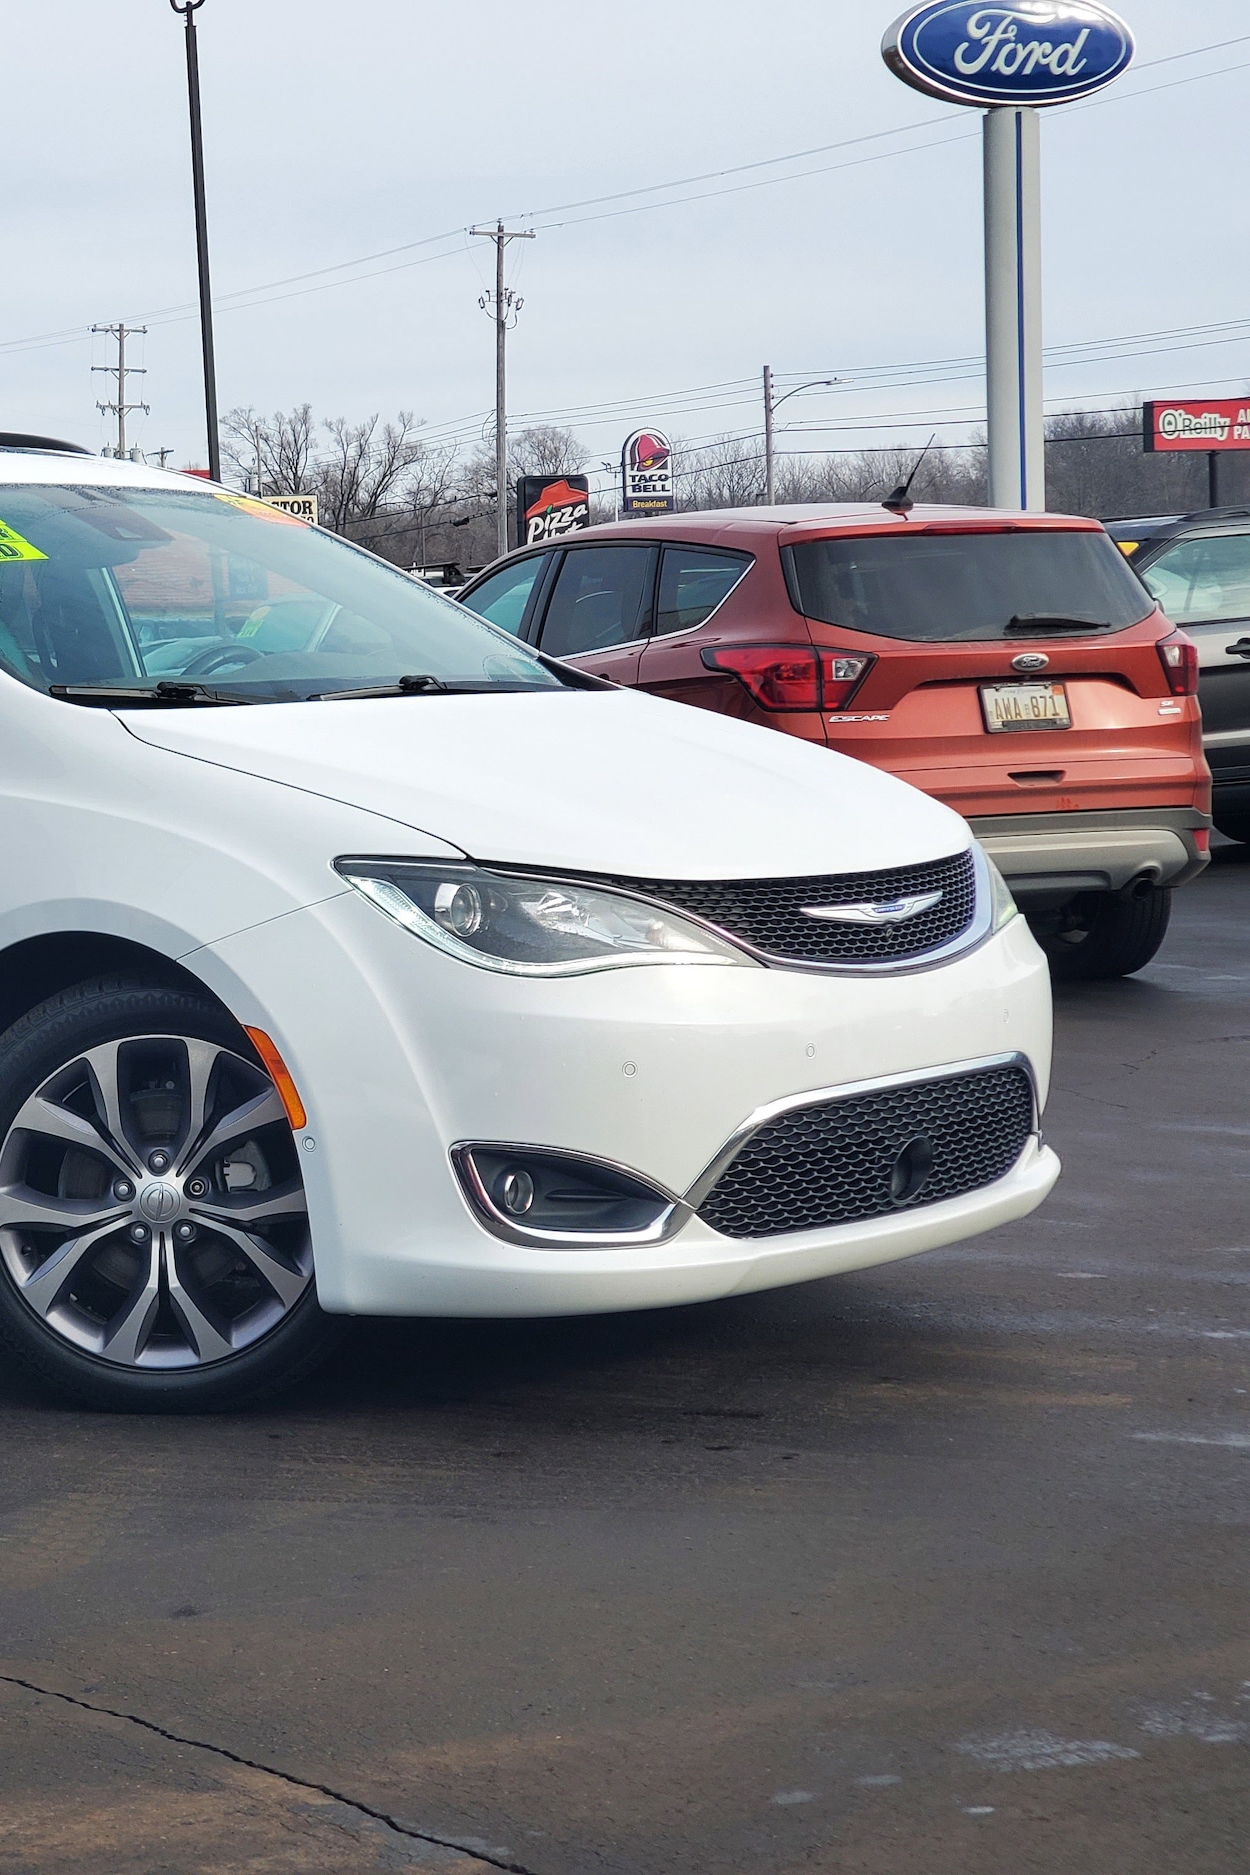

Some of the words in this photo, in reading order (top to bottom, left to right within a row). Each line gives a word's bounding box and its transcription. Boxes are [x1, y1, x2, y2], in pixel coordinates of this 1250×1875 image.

[954, 8, 1091, 76] Ford
[1160, 410, 1230, 440] O'Reilly
[628, 473, 669, 483] TACO
[631, 483, 671, 493] BELL
[271, 500, 314, 515] TOR
[632, 500, 668, 509] Breakfast
[527, 503, 589, 545] Pizza
[828, 714, 890, 723] ESCAPE
